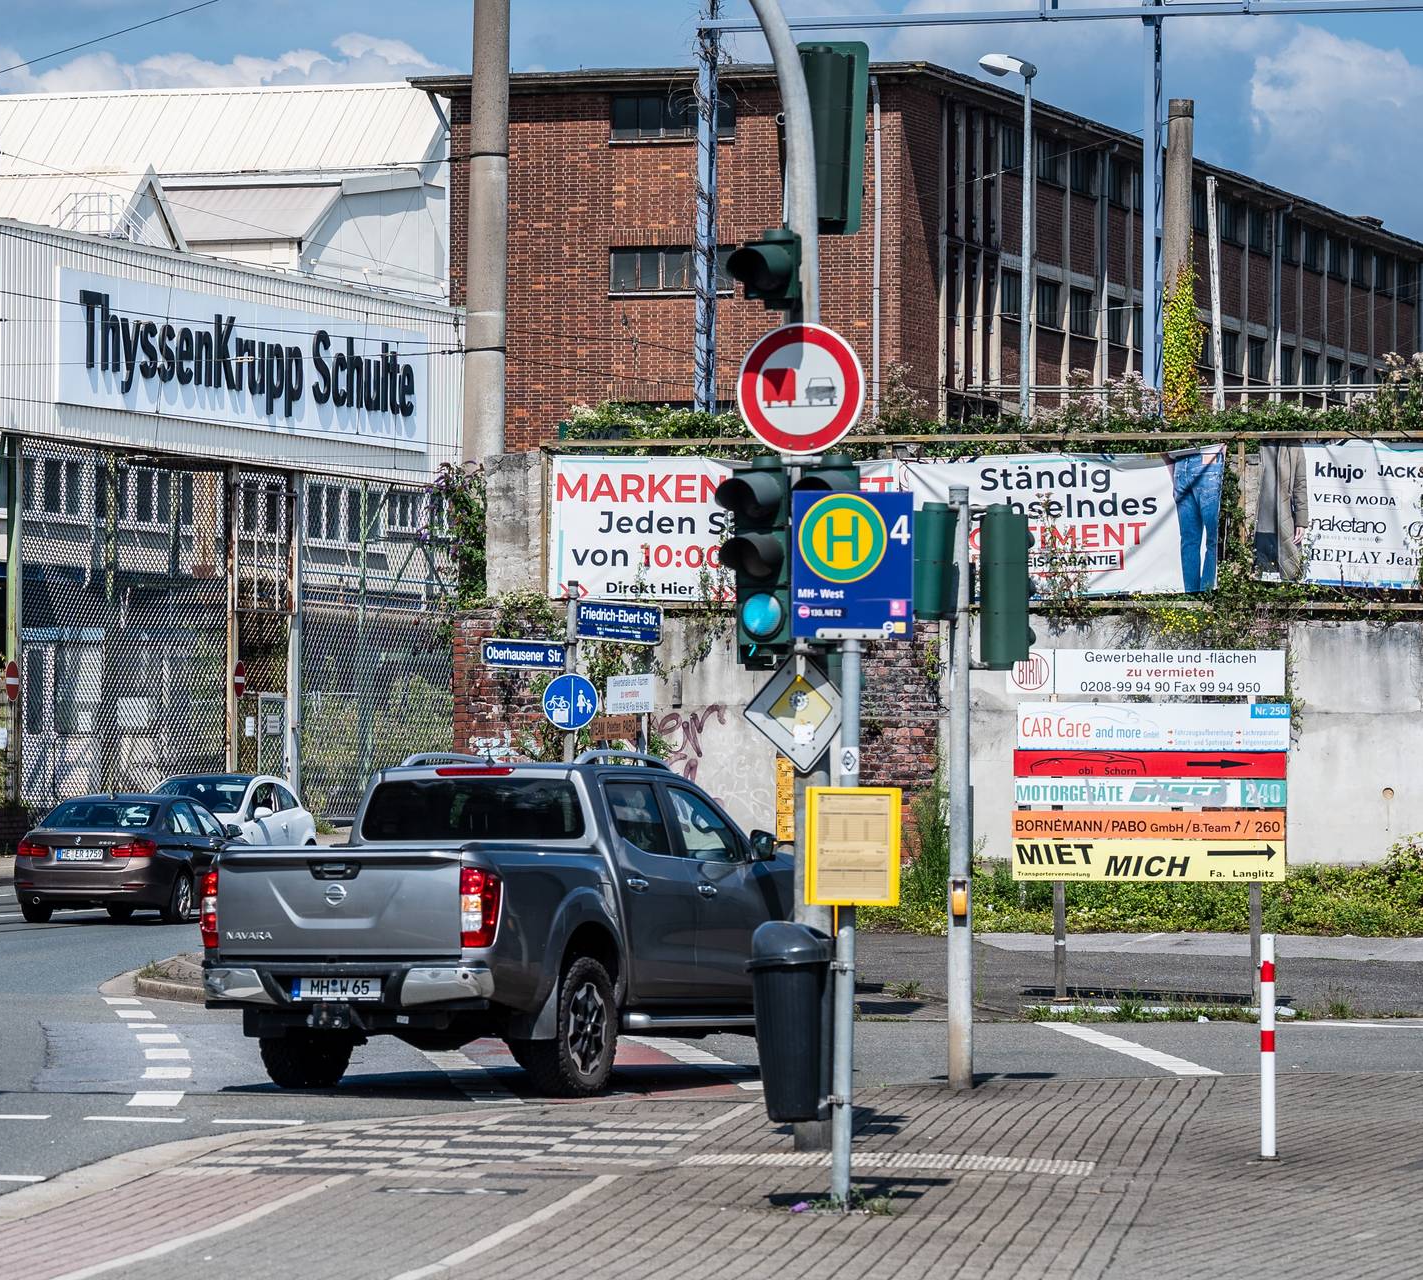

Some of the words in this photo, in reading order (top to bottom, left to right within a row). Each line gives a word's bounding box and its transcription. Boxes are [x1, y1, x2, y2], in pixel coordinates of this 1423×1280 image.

[79, 289, 304, 418] ThyssenKrupp
[311, 329, 415, 417] Schulte
[980, 462, 1111, 493] Ständig
[1315, 462, 1364, 483] khujo
[1313, 493, 1351, 505] VERO
[1355, 495, 1396, 506] MODA
[598, 510, 696, 535] Jeden
[889, 514, 911, 545] 4
[1311, 515, 1387, 534] naketano
[826, 516, 859, 562] H
[571, 548, 629, 567] von
[1311, 548, 1381, 564] REPLAY
[606, 581, 656, 594] Direkt
[661, 582, 695, 595] Hier
[820, 589, 845, 599] West
[580, 606, 658, 626] Friedrich-Ebert-Str.
[486, 646, 544, 662] Oberhausener
[547, 649, 564, 663] Str.
[1084, 651, 1174, 664] Gewerbehalle
[1177, 652, 1202, 664] und
[1018, 656, 1042, 685] BIRN
[1126, 668, 1143, 677] zu
[1146, 667, 1214, 678] vermieten
[1080, 681, 1133, 693] 0208-99
[1135, 681, 1151, 693] 94
[1154, 681, 1170, 693] 90
[1174, 682, 1196, 693] Fax
[1199, 682, 1215, 693] 99
[1218, 682, 1234, 693] 94
[1237, 682, 1261, 693] 950
[1254, 706, 1267, 716] Nr.
[1269, 706, 1287, 716] 250
[1022, 717, 1052, 738] CAR
[1057, 717, 1091, 738] Care
[1095, 725, 1114, 738] and
[1116, 727, 1141, 738] more
[1078, 766, 1094, 776] obi
[1104, 766, 1137, 776] Schorn
[1015, 783, 1124, 802] MOTORGERÄTE
[1245, 783, 1282, 804] 240
[1255, 821, 1280, 833] 260
[1015, 843, 1094, 865] MIET
[1017, 870, 1091, 878] Transportervermietung
[1104, 855, 1191, 877] MICH
[1209, 869, 1226, 878] Fa.
[1232, 869, 1275, 879] Langlitz
[226, 930, 273, 941] NAVARA
[310, 980, 329, 995] MH
[340, 980, 349, 995] W
[352, 980, 370, 995] 65
